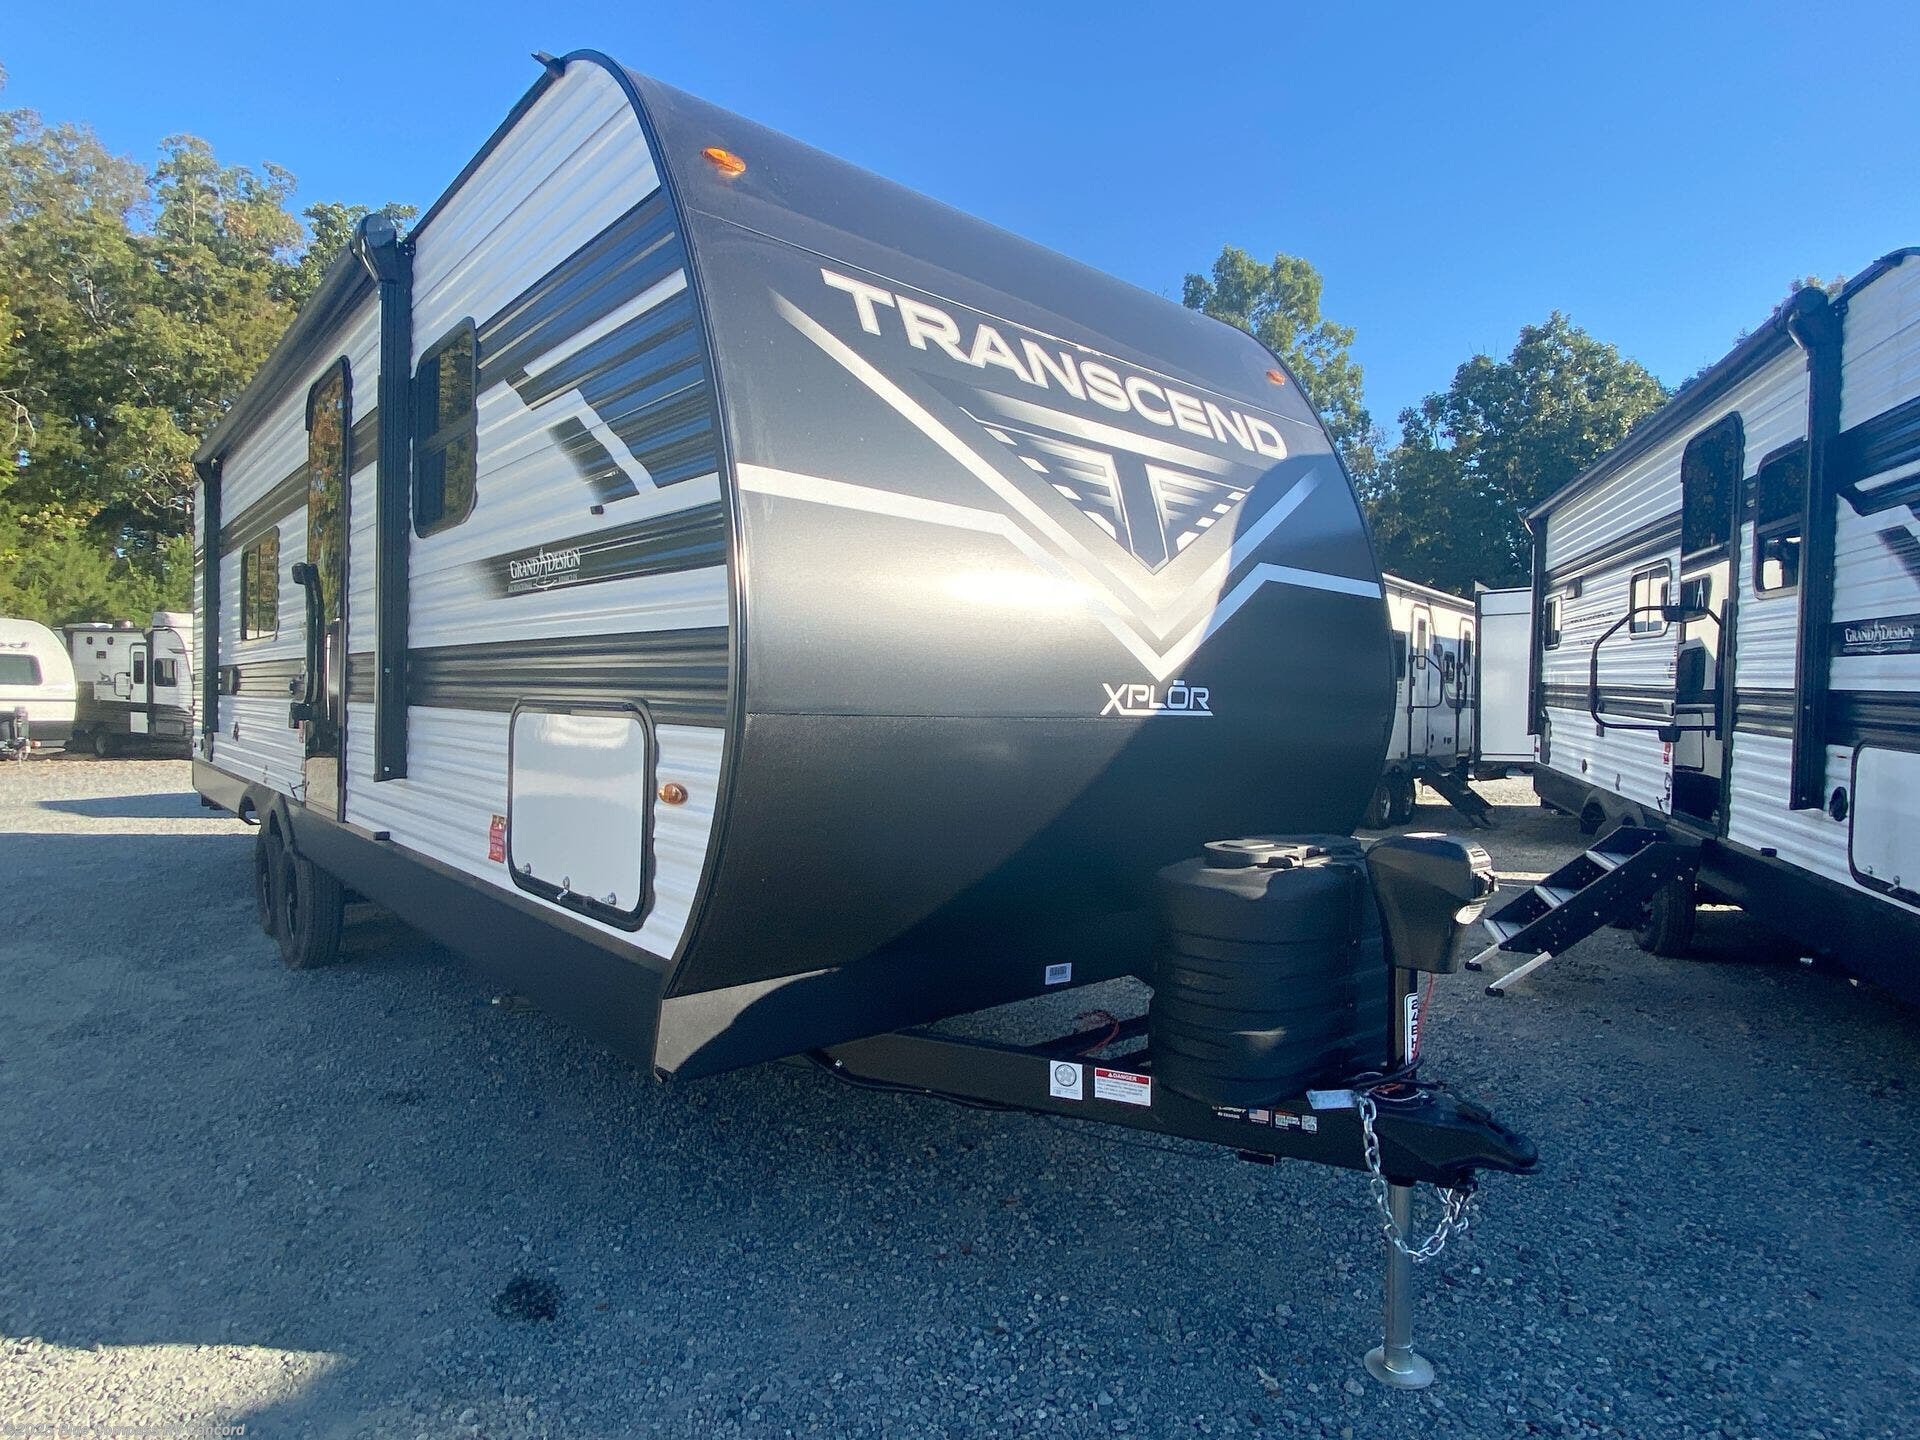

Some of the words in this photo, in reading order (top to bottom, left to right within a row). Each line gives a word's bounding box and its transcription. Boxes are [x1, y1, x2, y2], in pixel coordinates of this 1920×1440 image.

[819, 267, 1288, 461] TRANSCEND
[509, 557, 540, 579] GRAND
[546, 548, 581, 572] DESIGN
[1844, 627, 1874, 643] GRAND
[1112, 1071, 1138, 1082] DANGER
